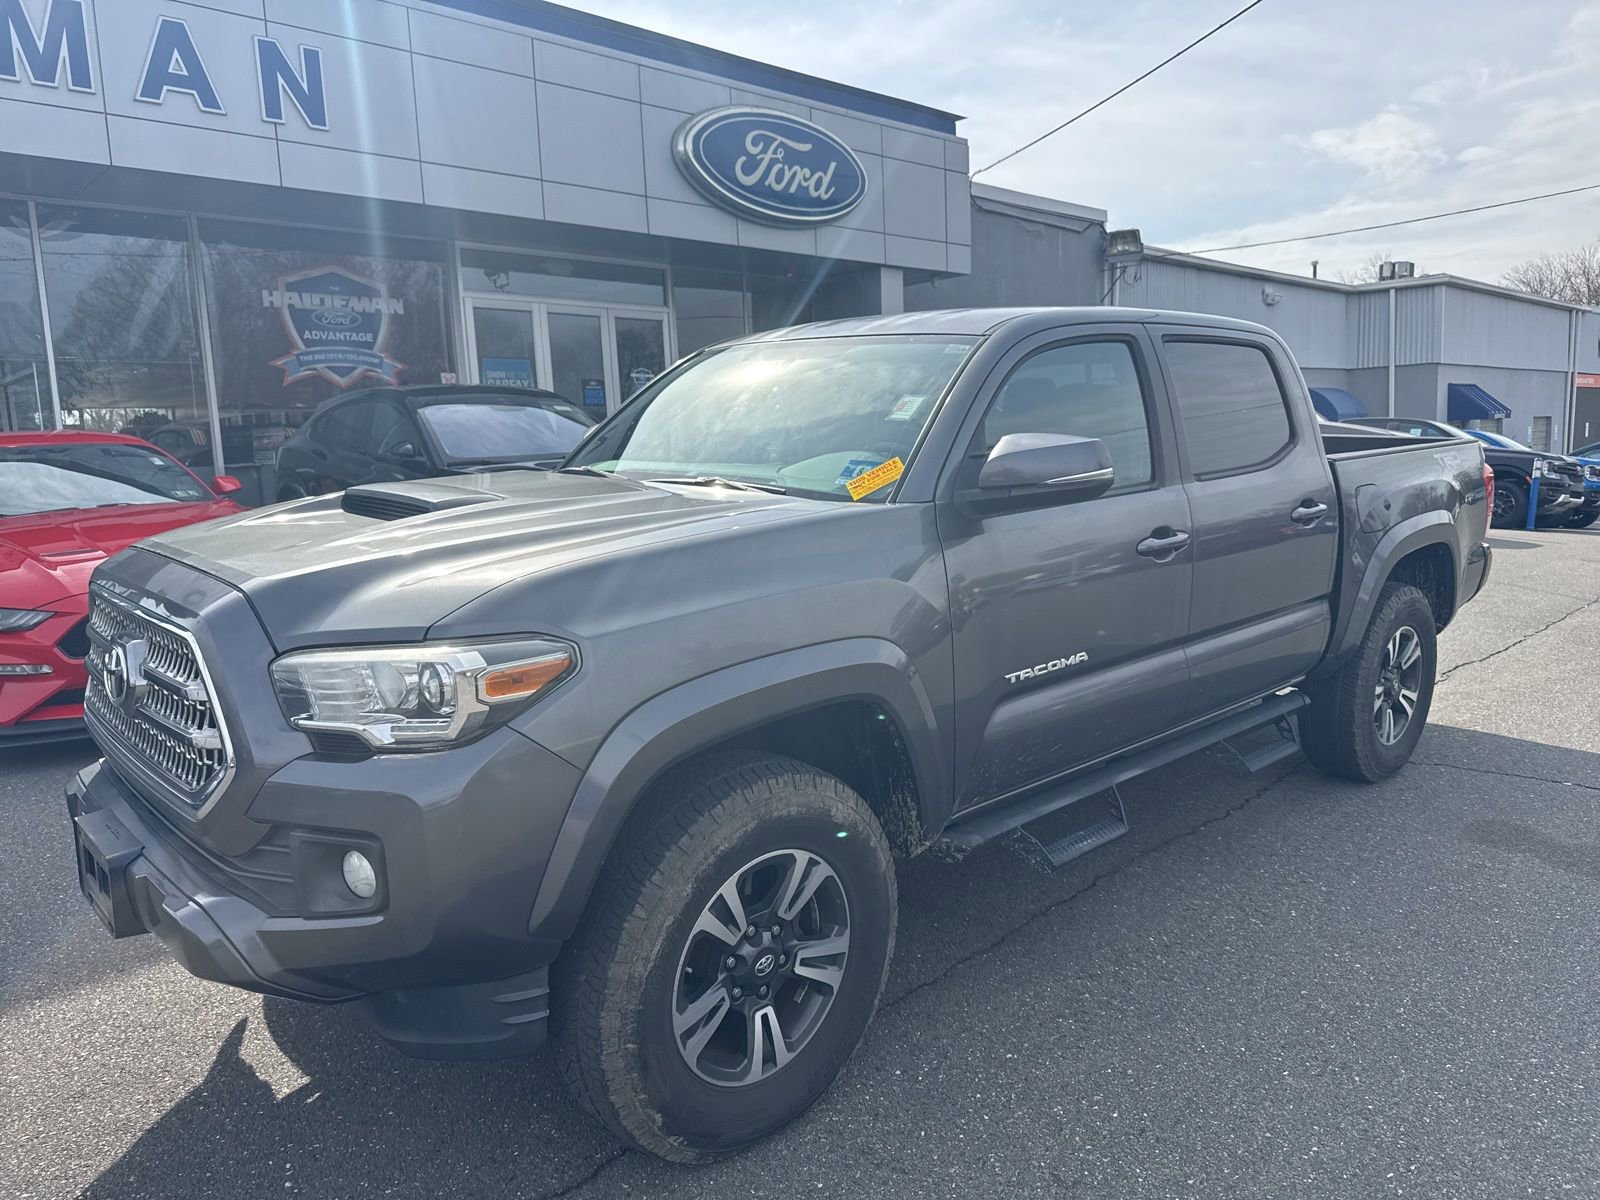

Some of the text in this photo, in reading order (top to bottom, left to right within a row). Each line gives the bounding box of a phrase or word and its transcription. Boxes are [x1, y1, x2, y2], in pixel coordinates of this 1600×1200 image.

[734, 129, 837, 200] Ford
[262, 289, 404, 315] HALDEMAN
[321, 311, 352, 326] Ford
[303, 330, 374, 342] ADVANTAGE
[866, 460, 899, 477] VEHICLE
[1003, 651, 1089, 684] TACOMA
